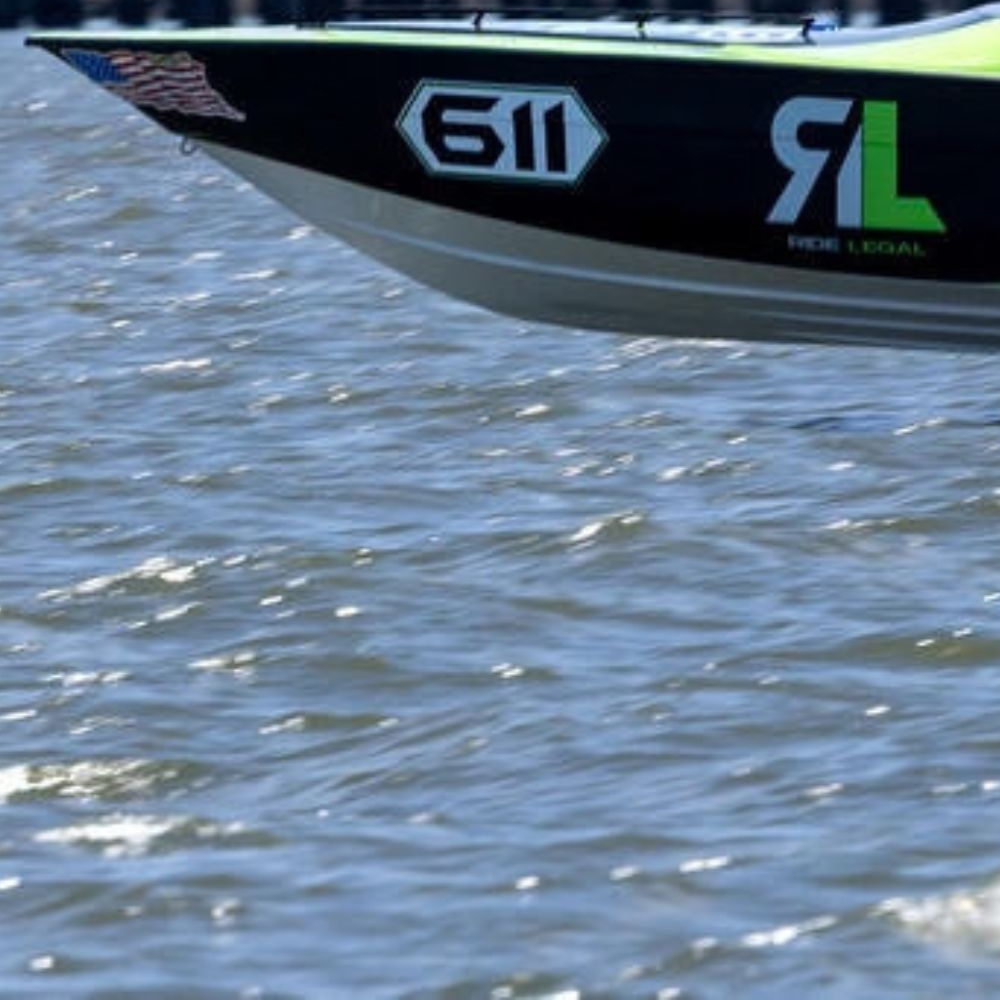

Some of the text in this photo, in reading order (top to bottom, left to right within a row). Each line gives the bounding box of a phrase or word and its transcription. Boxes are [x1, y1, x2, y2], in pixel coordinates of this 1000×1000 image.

[421, 94, 568, 174] 611
[787, 234, 927, 257] RIDE LEGAL
